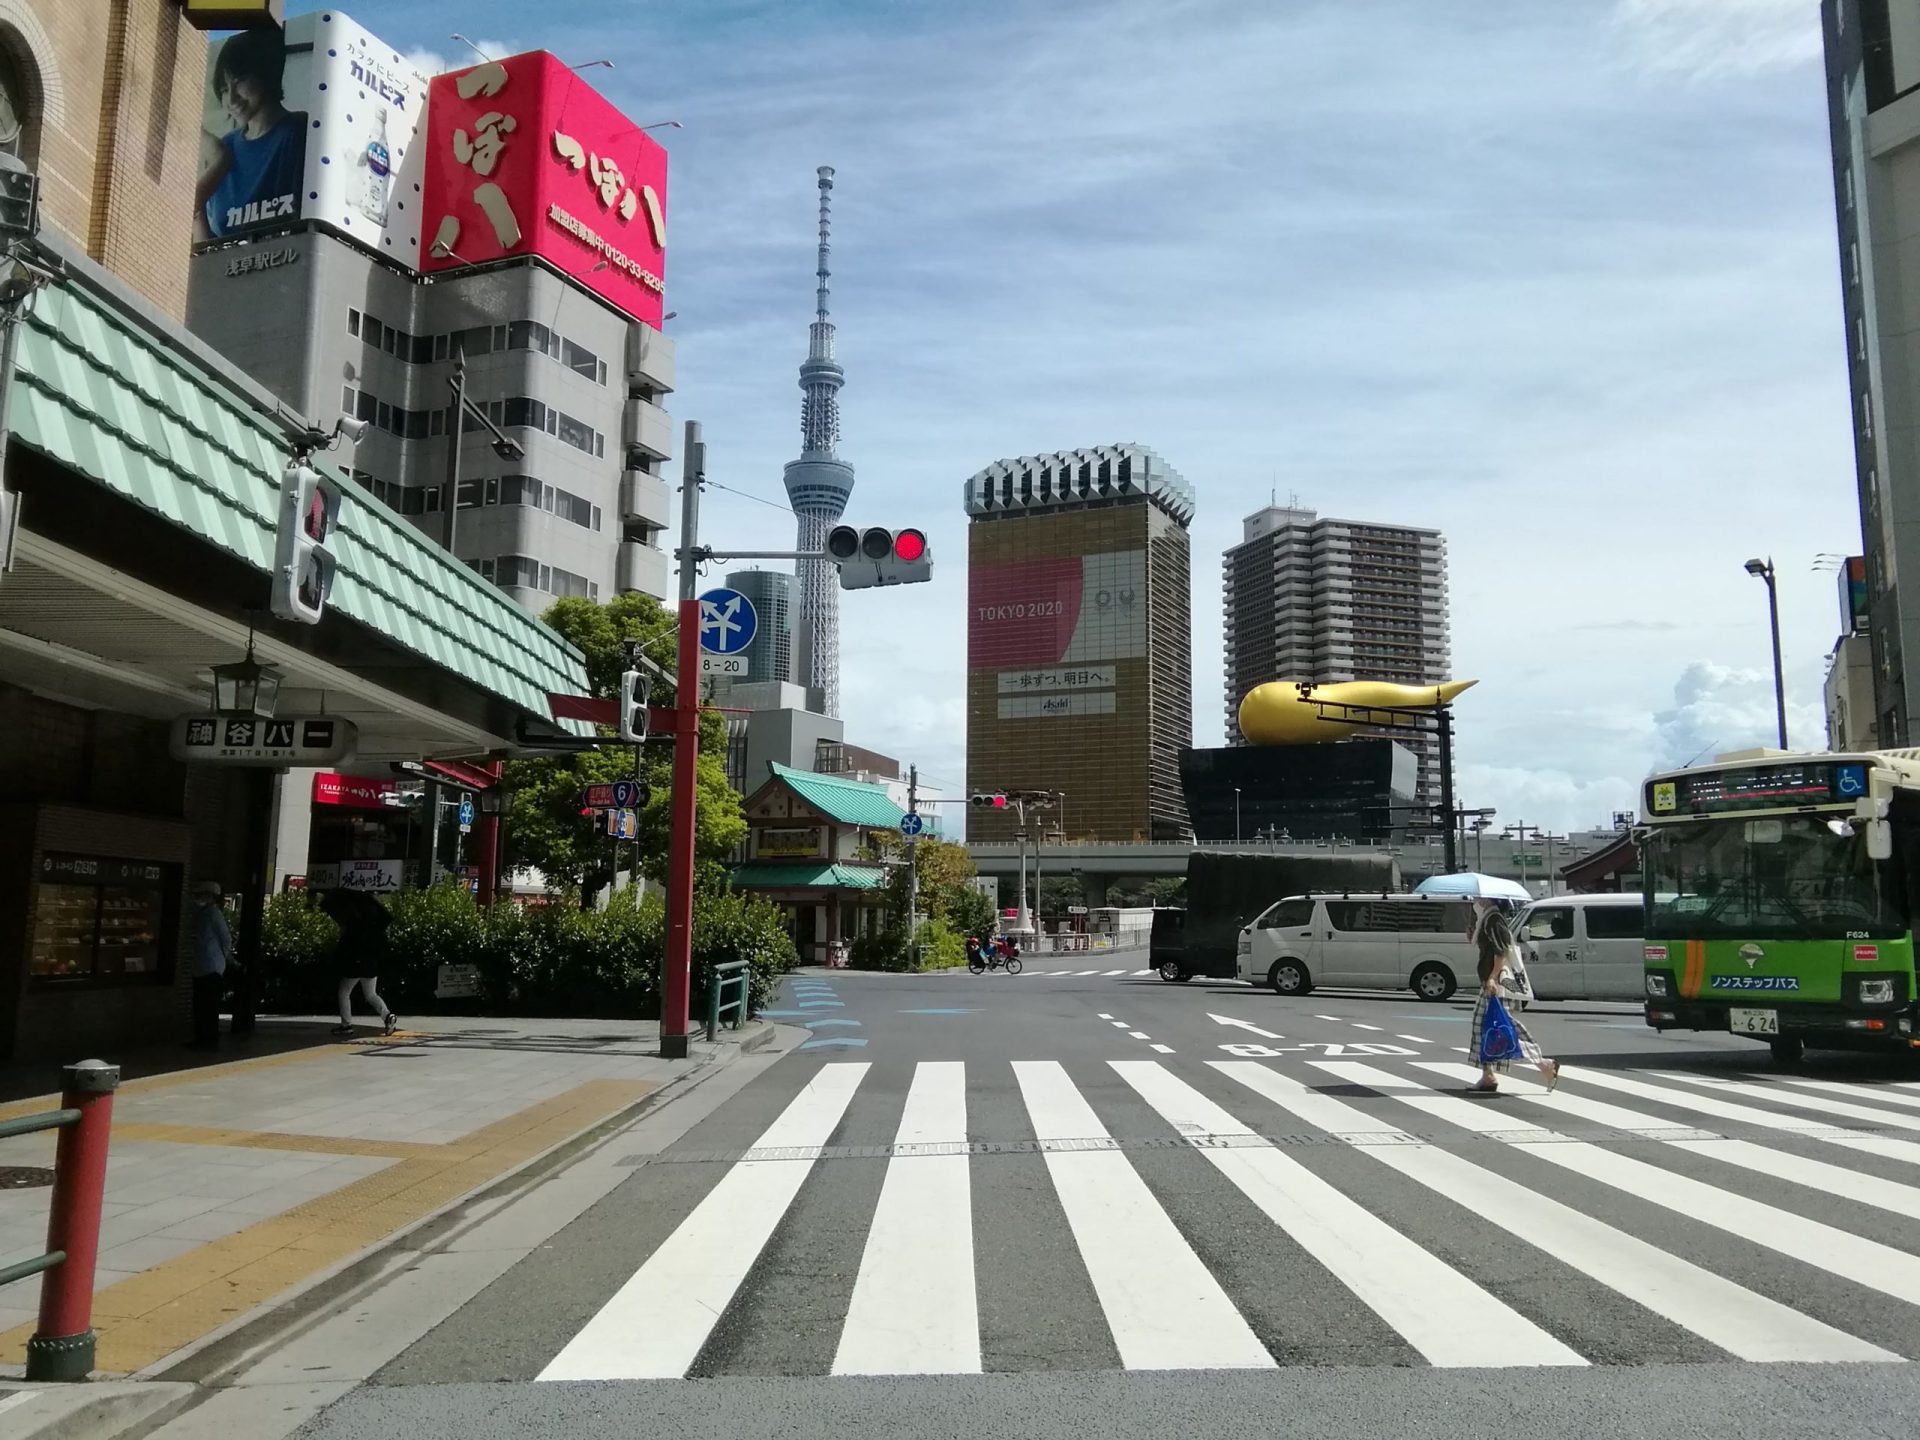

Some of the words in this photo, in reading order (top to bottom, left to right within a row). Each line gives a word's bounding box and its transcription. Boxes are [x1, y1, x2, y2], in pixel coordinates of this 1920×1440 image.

[347, 43, 410, 94] カラダにピース
[350, 60, 405, 111] カルピス
[429, 63, 522, 259] つぼ八
[554, 130, 667, 248] つぼ八
[226, 193, 295, 228] カルピス
[224, 248, 297, 276] 浅草駅ビル
[978, 604, 1025, 621] TOKYO
[1028, 601, 1063, 617] 2020
[1005, 671, 1109, 688] 一歩ずつ、明日へ。
[1043, 698, 1069, 709] Asahi
[187, 721, 331, 746] 神谷バー
[320, 784, 349, 793] IZAKAYA
[617, 785, 626, 800] 6
[1846, 931, 1870, 939] F624
[1712, 976, 1799, 989] ノンステップバス
